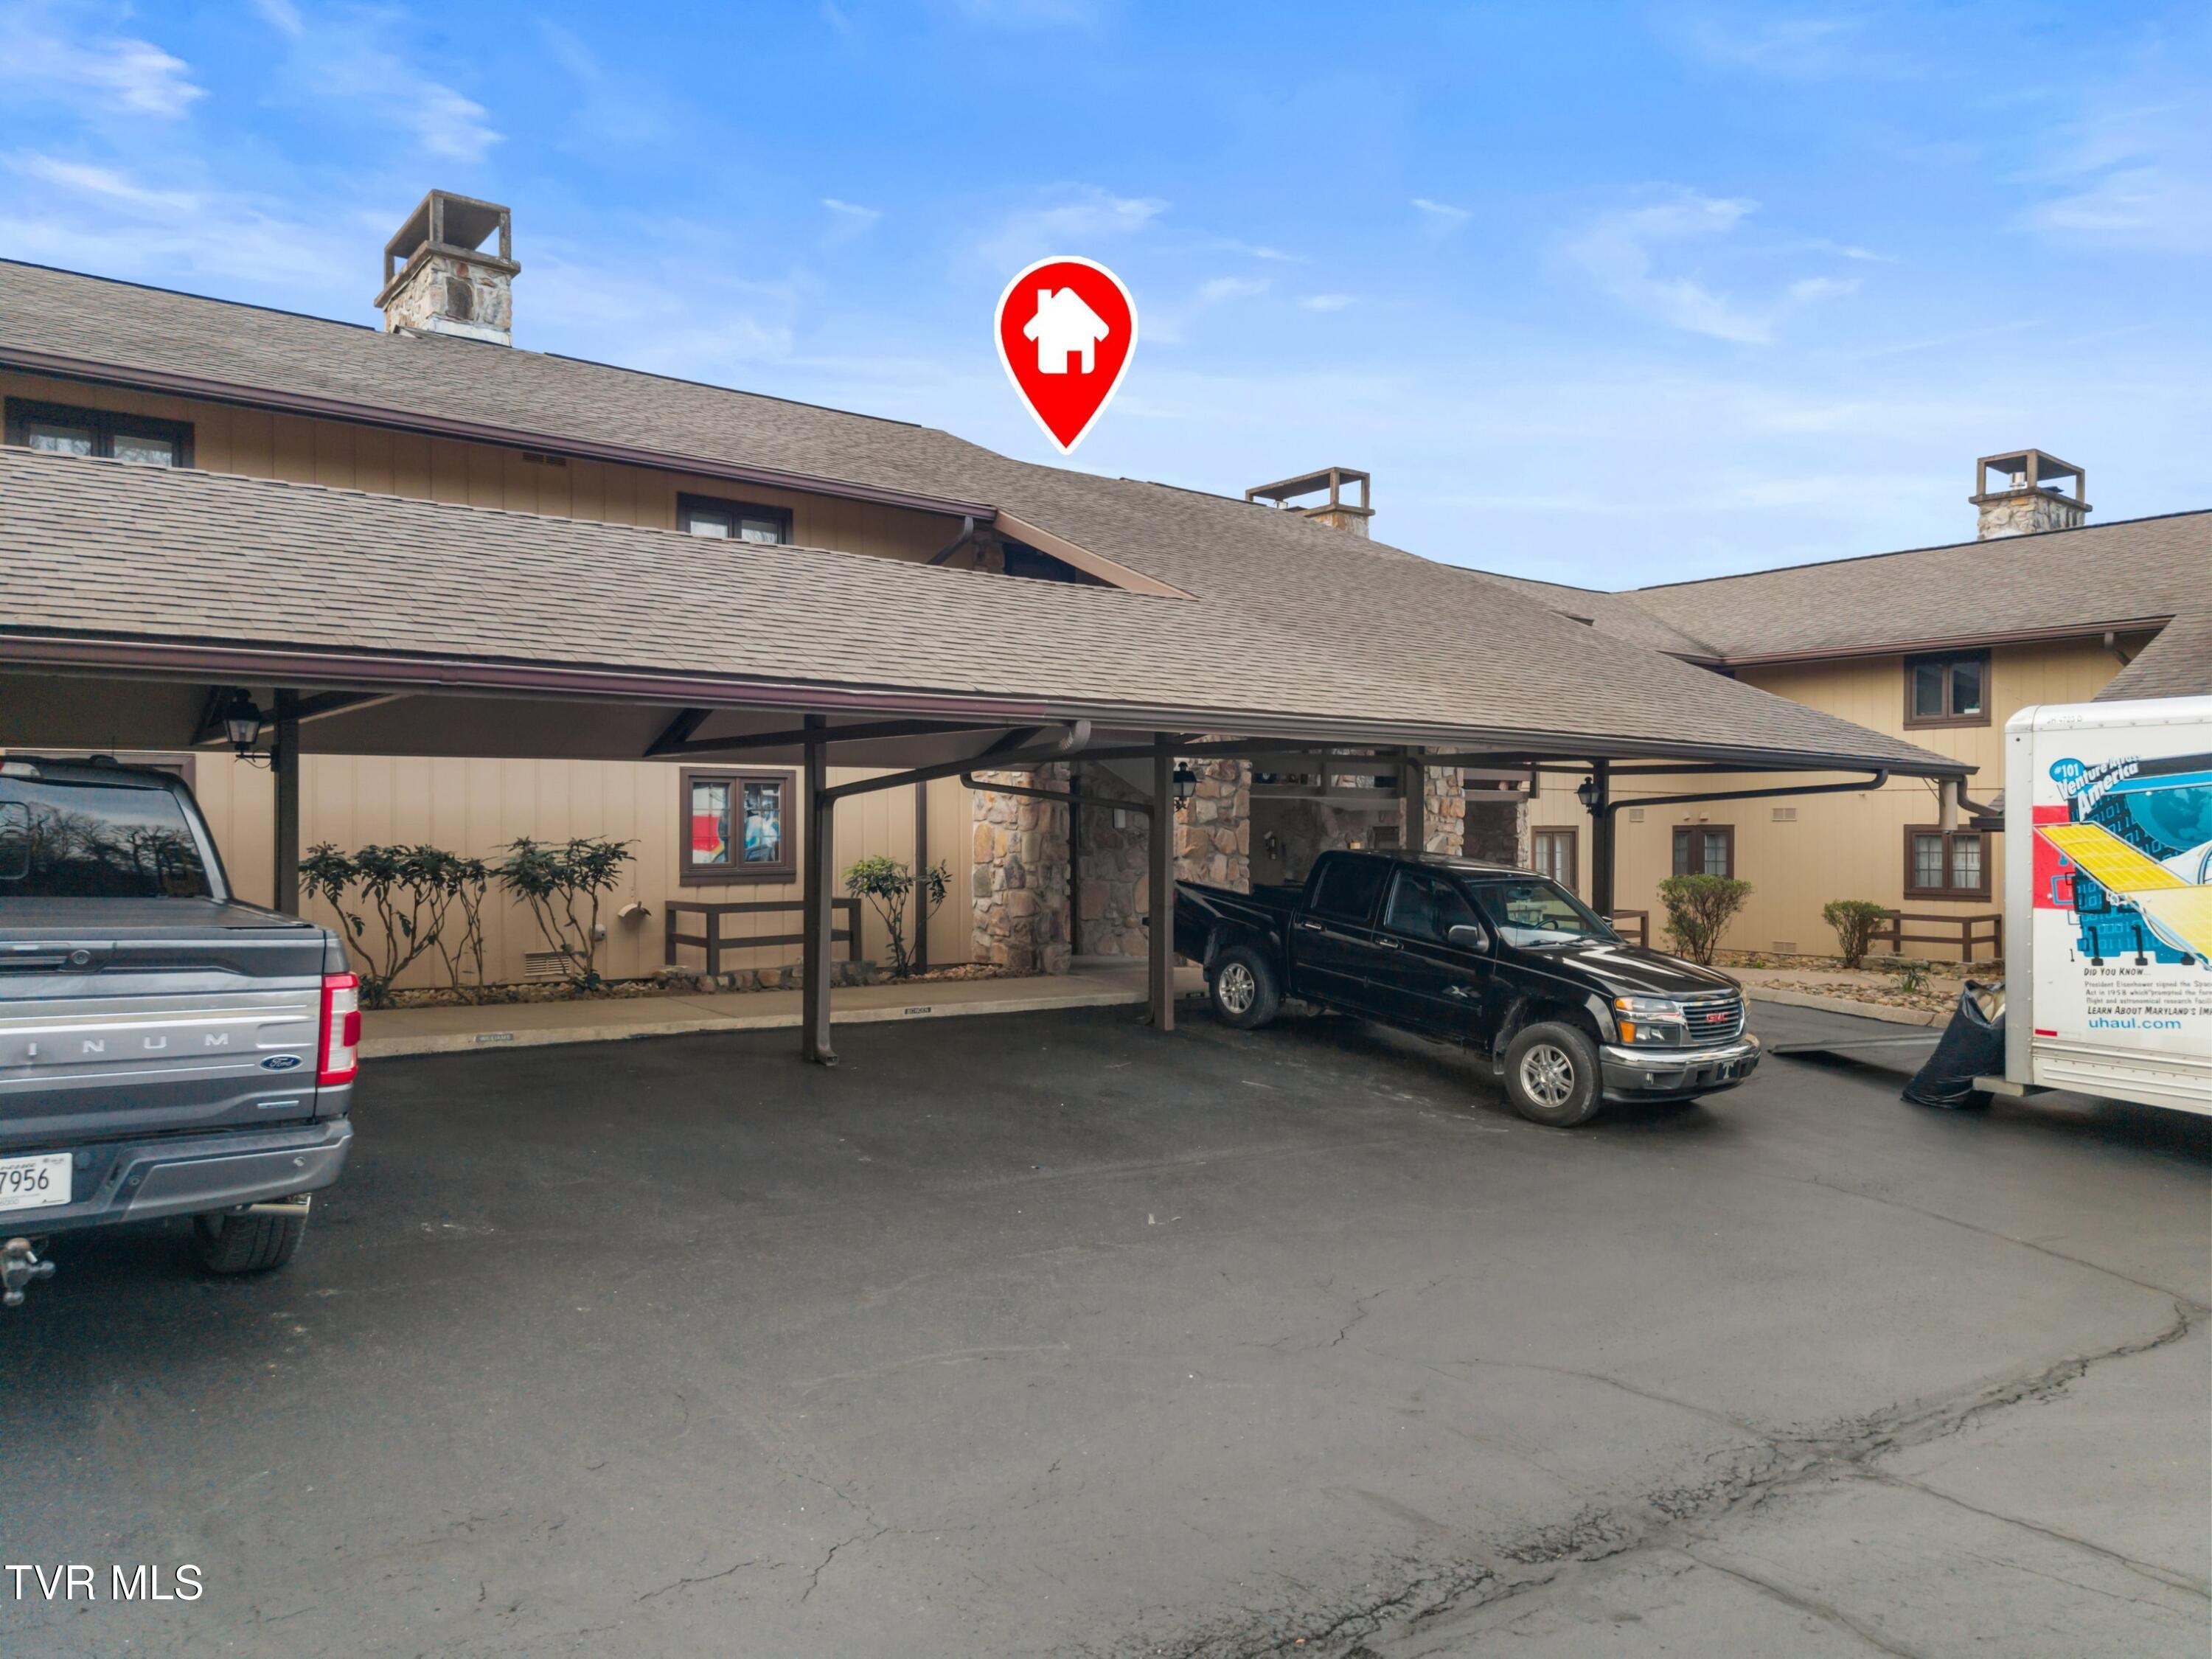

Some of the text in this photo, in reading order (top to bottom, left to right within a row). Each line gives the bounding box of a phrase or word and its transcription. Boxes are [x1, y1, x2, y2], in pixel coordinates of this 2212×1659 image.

[2053, 763, 2079, 778] #101
[2056, 762, 2107, 801] Venture
[2077, 762, 2139, 822] America
[2084, 967, 2097, 975] DID
[2100, 967, 2116, 975] YOU
[2156, 981, 2177, 989] signed
[2087, 1006, 2112, 1015] LEARN
[2115, 1006, 2142, 1015] ABOUT
[2145, 1006, 2196, 1015] MARYLAND'S
[1705, 1012, 1730, 1023] GMC
[2088, 1018, 2182, 1029] uhaul.com
[269, 1057, 294, 1067] Ford
[0, 1168, 49, 1194] 7956
